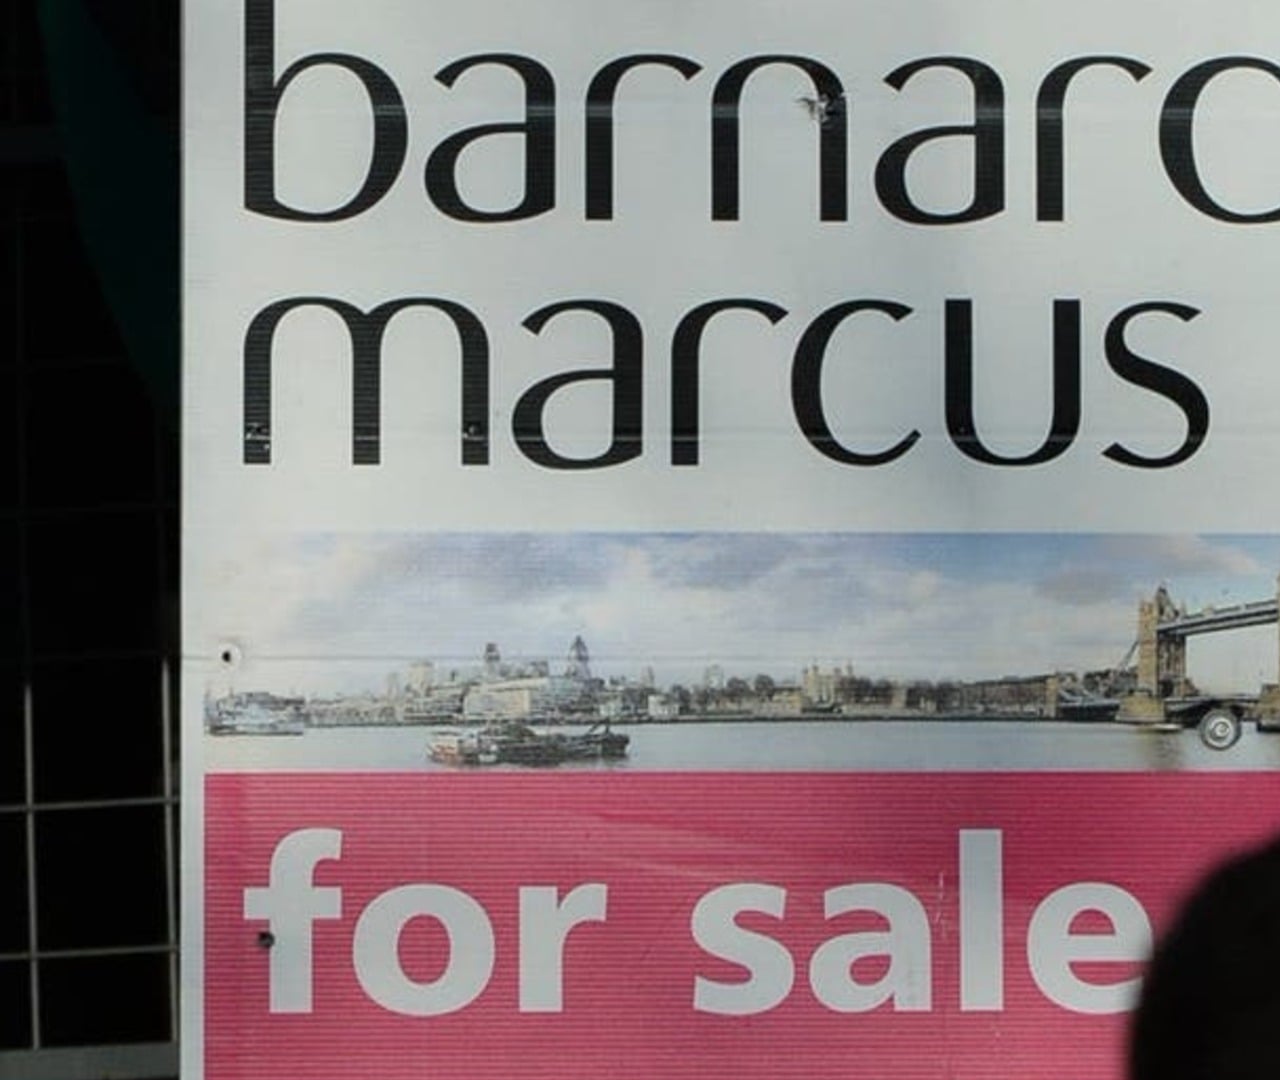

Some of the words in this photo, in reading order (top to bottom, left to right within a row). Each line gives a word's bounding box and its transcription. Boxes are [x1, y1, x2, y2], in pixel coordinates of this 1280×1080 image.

[243, 296, 1211, 470] marcus
[242, 827, 609, 1017] for
[689, 828, 1155, 1016] sale
